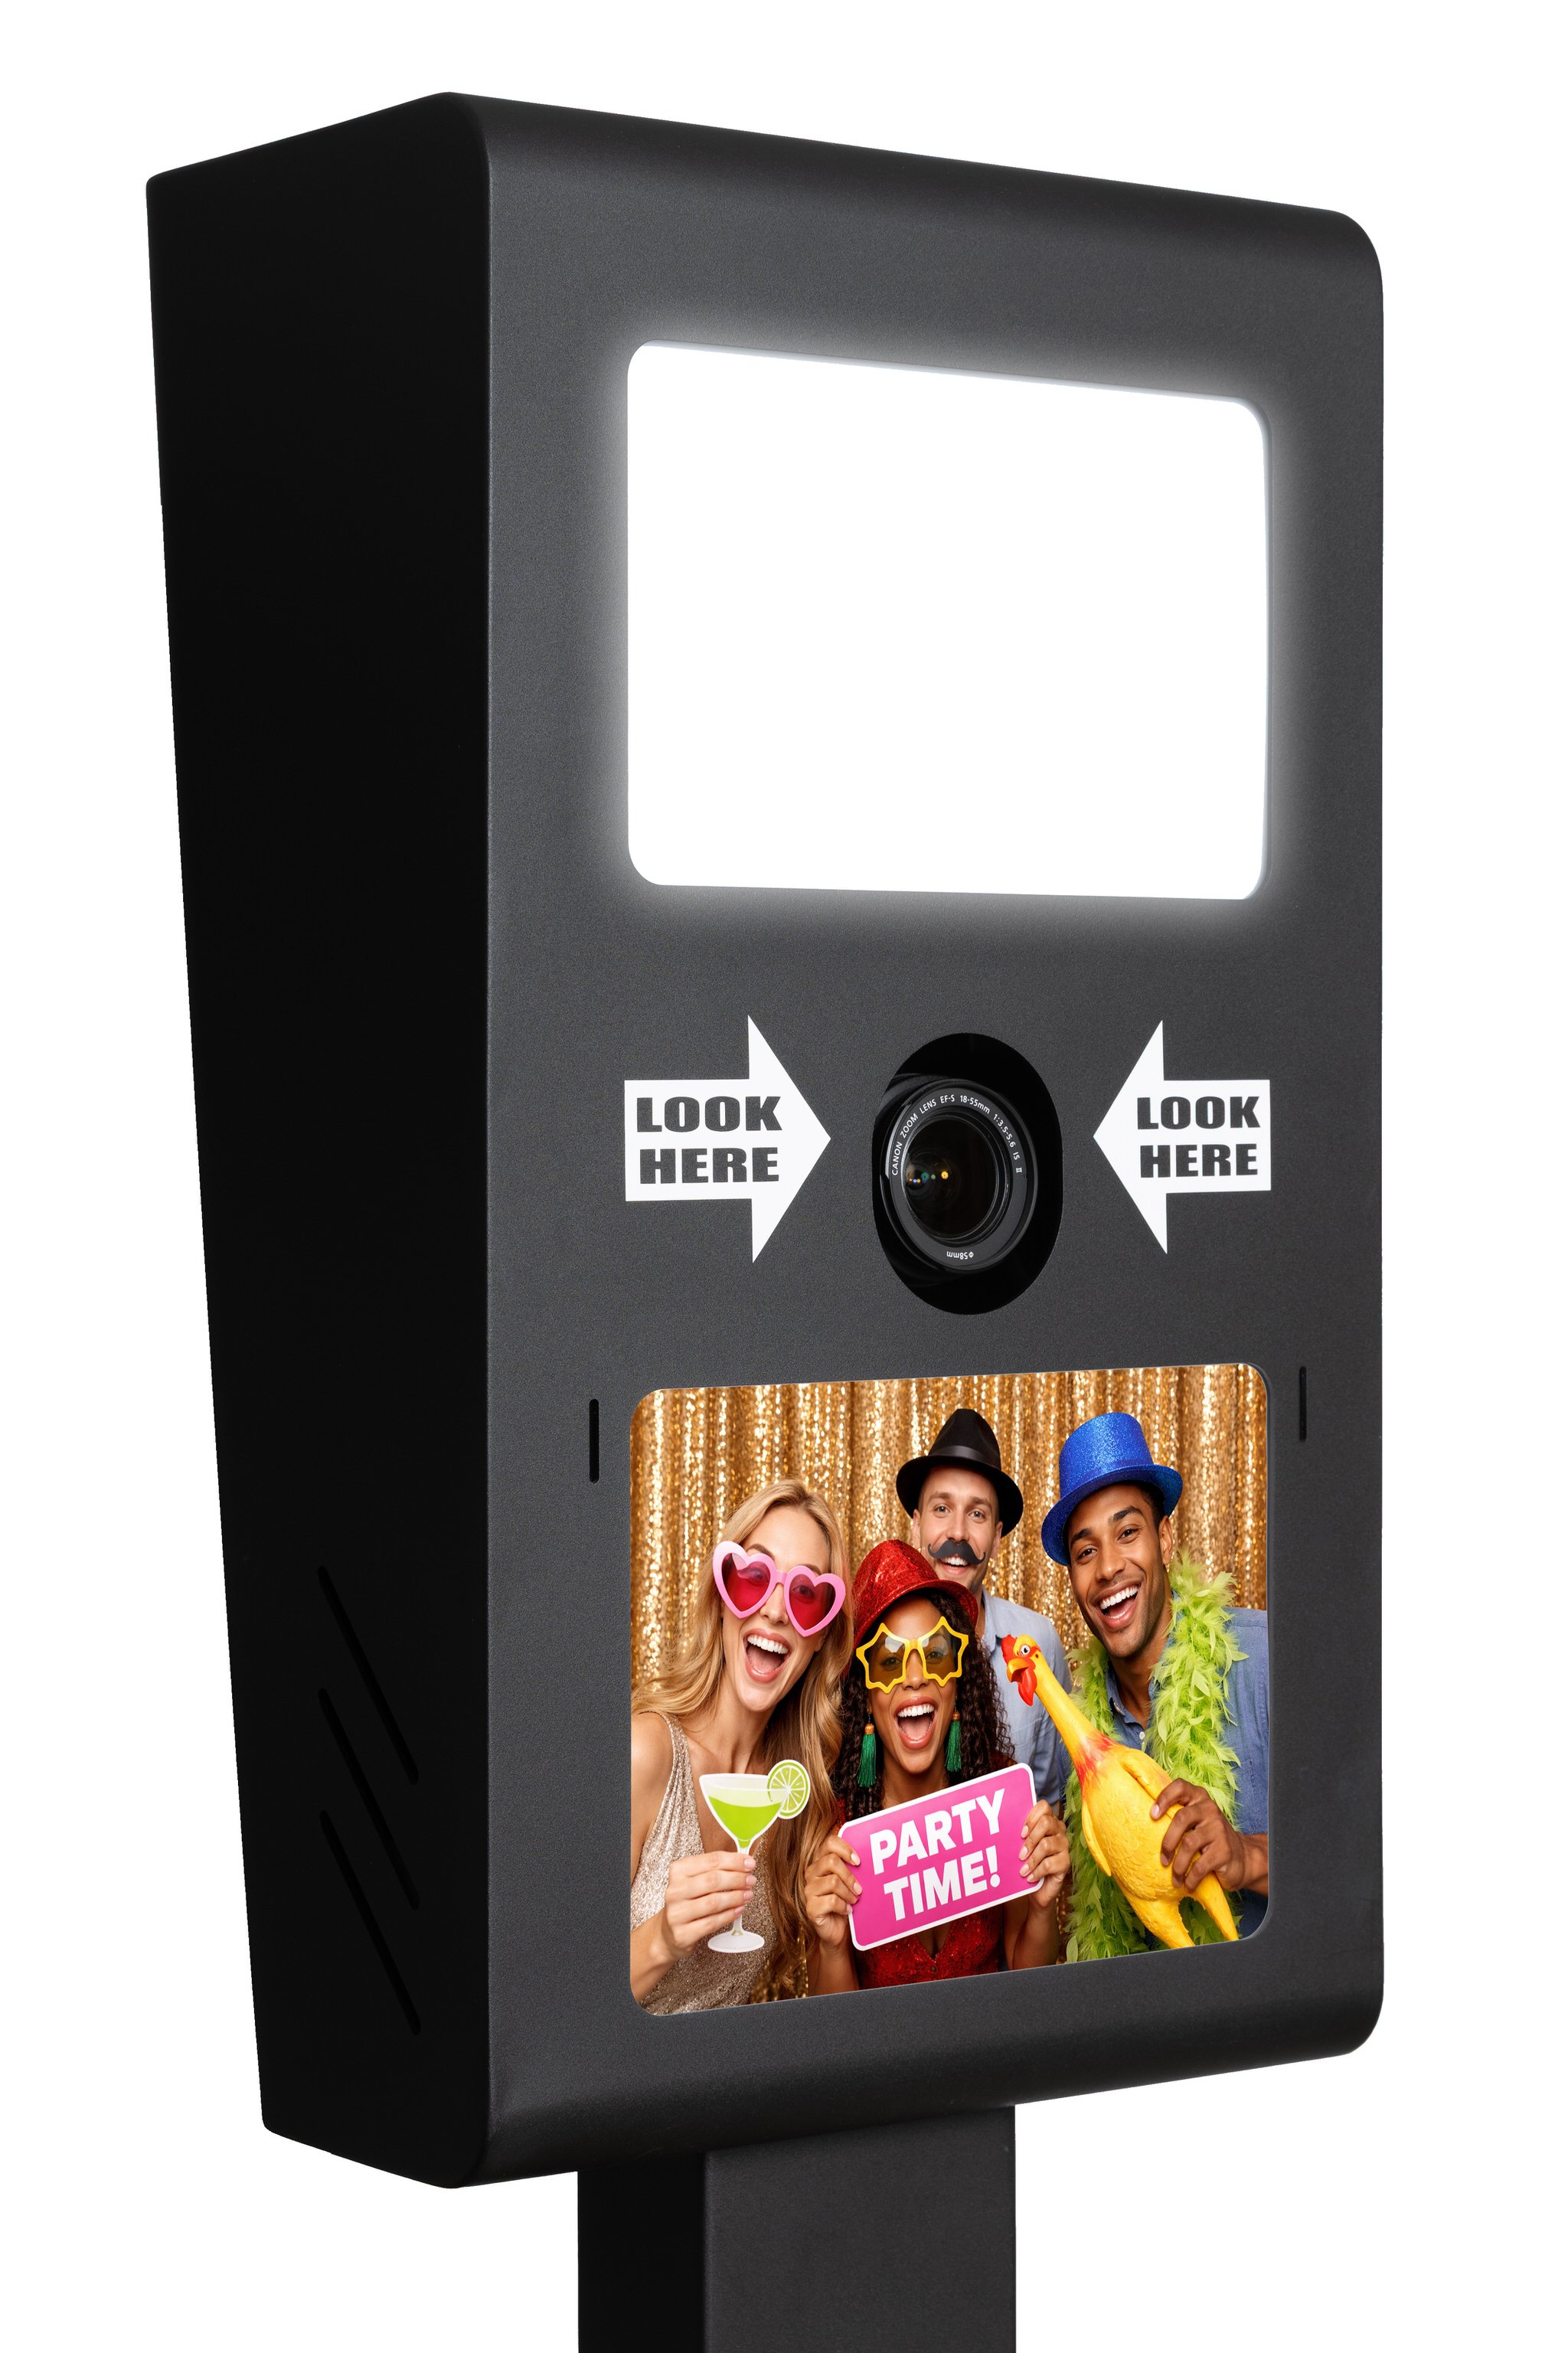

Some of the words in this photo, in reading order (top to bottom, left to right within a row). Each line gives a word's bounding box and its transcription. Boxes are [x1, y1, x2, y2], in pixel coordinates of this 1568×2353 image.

[637, 1096, 782, 1132] LOOK
[1137, 1096, 1261, 1129] LOOK
[891, 1142, 903, 1176] CANON
[900, 1113, 919, 1139] ZOOM
[919, 1098, 937, 1114] LENS
[939, 1094, 956, 1104] EF-S
[959, 1095, 991, 1114] 18-55mm
[993, 1113, 1016, 1148] 1:3.5-5.6
[1012, 1152, 1020, 1160] IS
[640, 1147, 779, 1184] HERE
[1140, 1143, 1258, 1178] HERE
[869, 1788, 1005, 1875] PARTY
[884, 1845, 1001, 1921] TIME!
